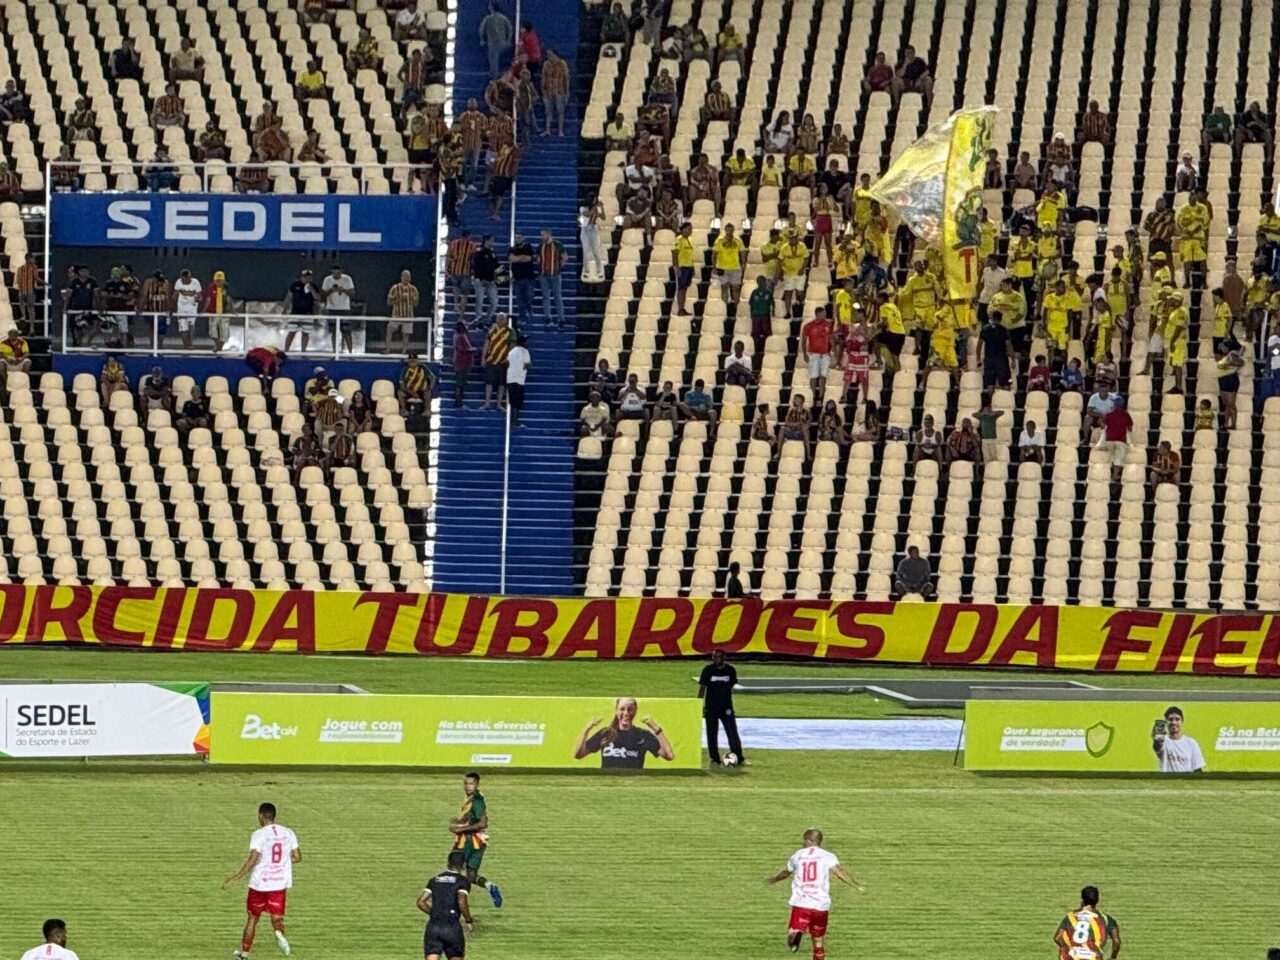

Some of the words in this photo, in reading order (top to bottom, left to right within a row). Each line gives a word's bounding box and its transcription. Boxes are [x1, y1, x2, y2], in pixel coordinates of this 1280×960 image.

[106, 200, 382, 243] SEDEL
[923, 602, 1058, 668] DA
[17, 704, 96, 726] SEDEL
[321, 718, 369, 732] Jogue
[370, 720, 403, 731] com
[15, 727, 56, 736] Secretaria
[56, 727, 68, 736] de
[69, 727, 97, 736] Estado
[15, 737, 27, 746] do
[29, 737, 60, 747] Esporte
[68, 737, 90, 746] Lazer
[1006, 738, 1019, 746] de
[1219, 726, 1235, 737] Só
[1237, 728, 1254, 737] na
[271, 842, 283, 864] 8
[801, 861, 818, 882] 10
[1073, 920, 1090, 944] 8
